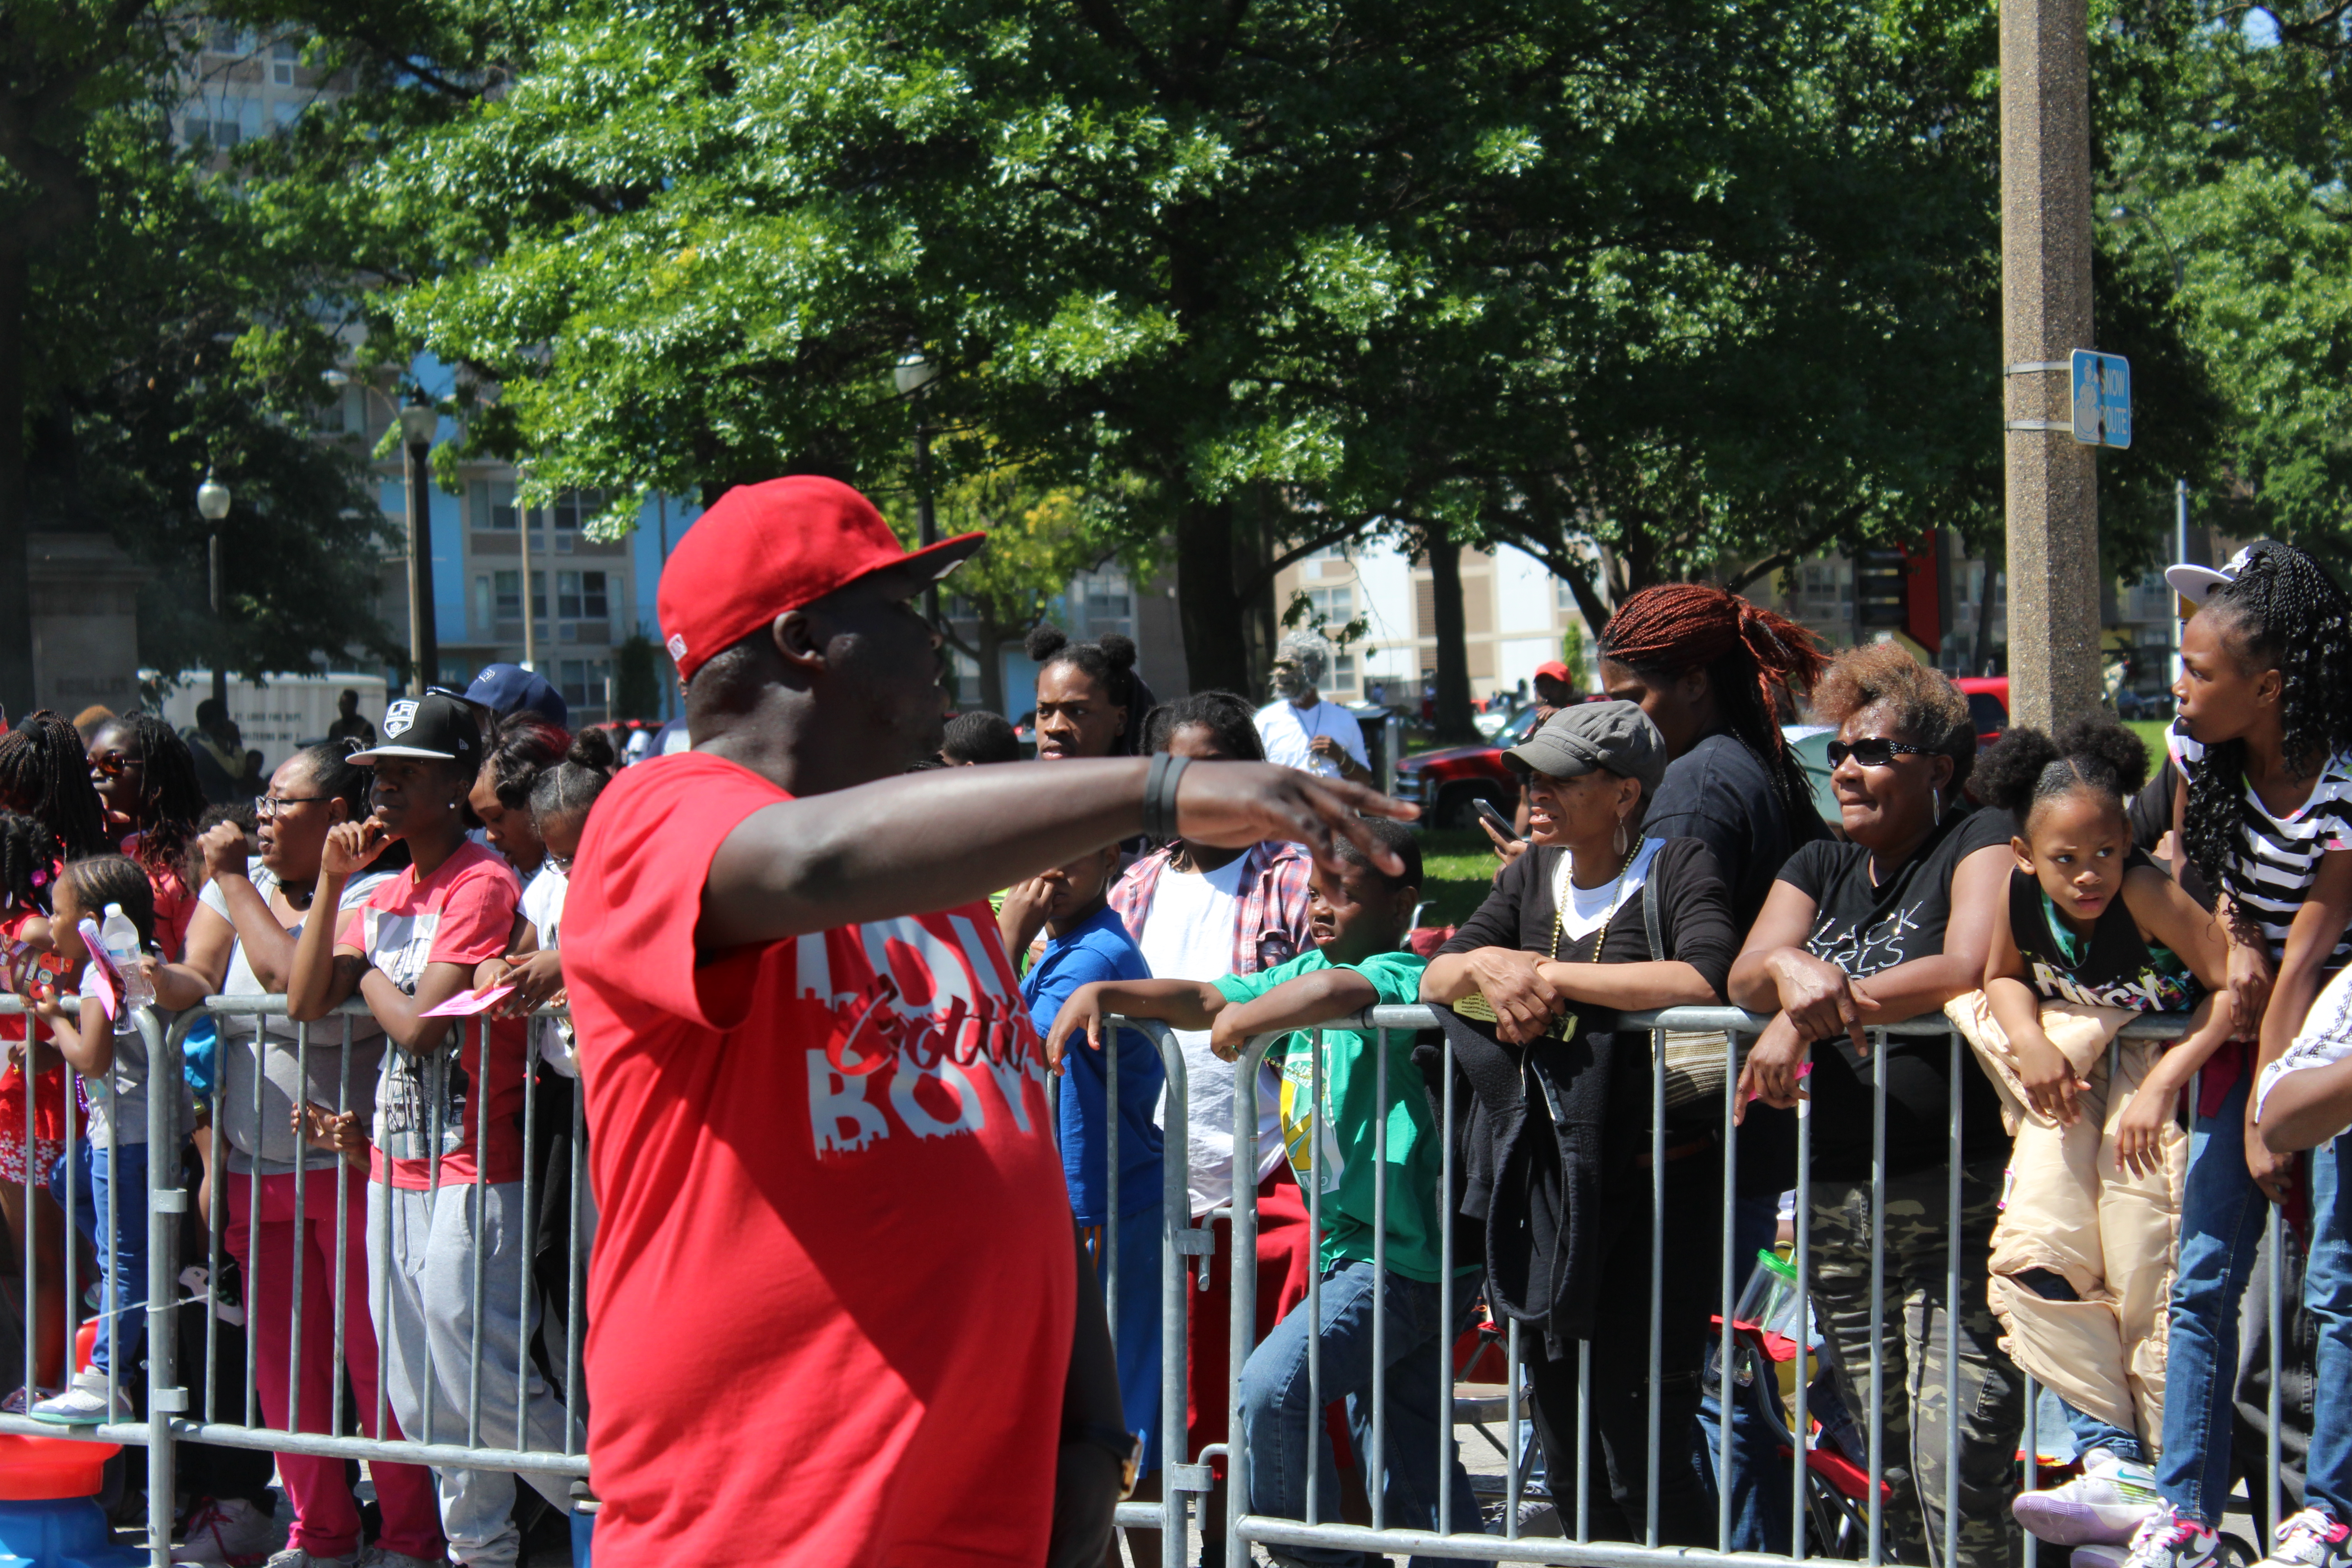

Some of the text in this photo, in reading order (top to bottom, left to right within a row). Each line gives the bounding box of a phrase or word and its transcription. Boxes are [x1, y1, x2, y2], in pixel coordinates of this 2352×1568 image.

[2100, 368, 2125, 397] SNOW
[2099, 405, 2127, 435] ROUTE
[389, 704, 413, 716] LA
[1812, 900, 1923, 950] LACK
[806, 1049, 1044, 1161] BOY
